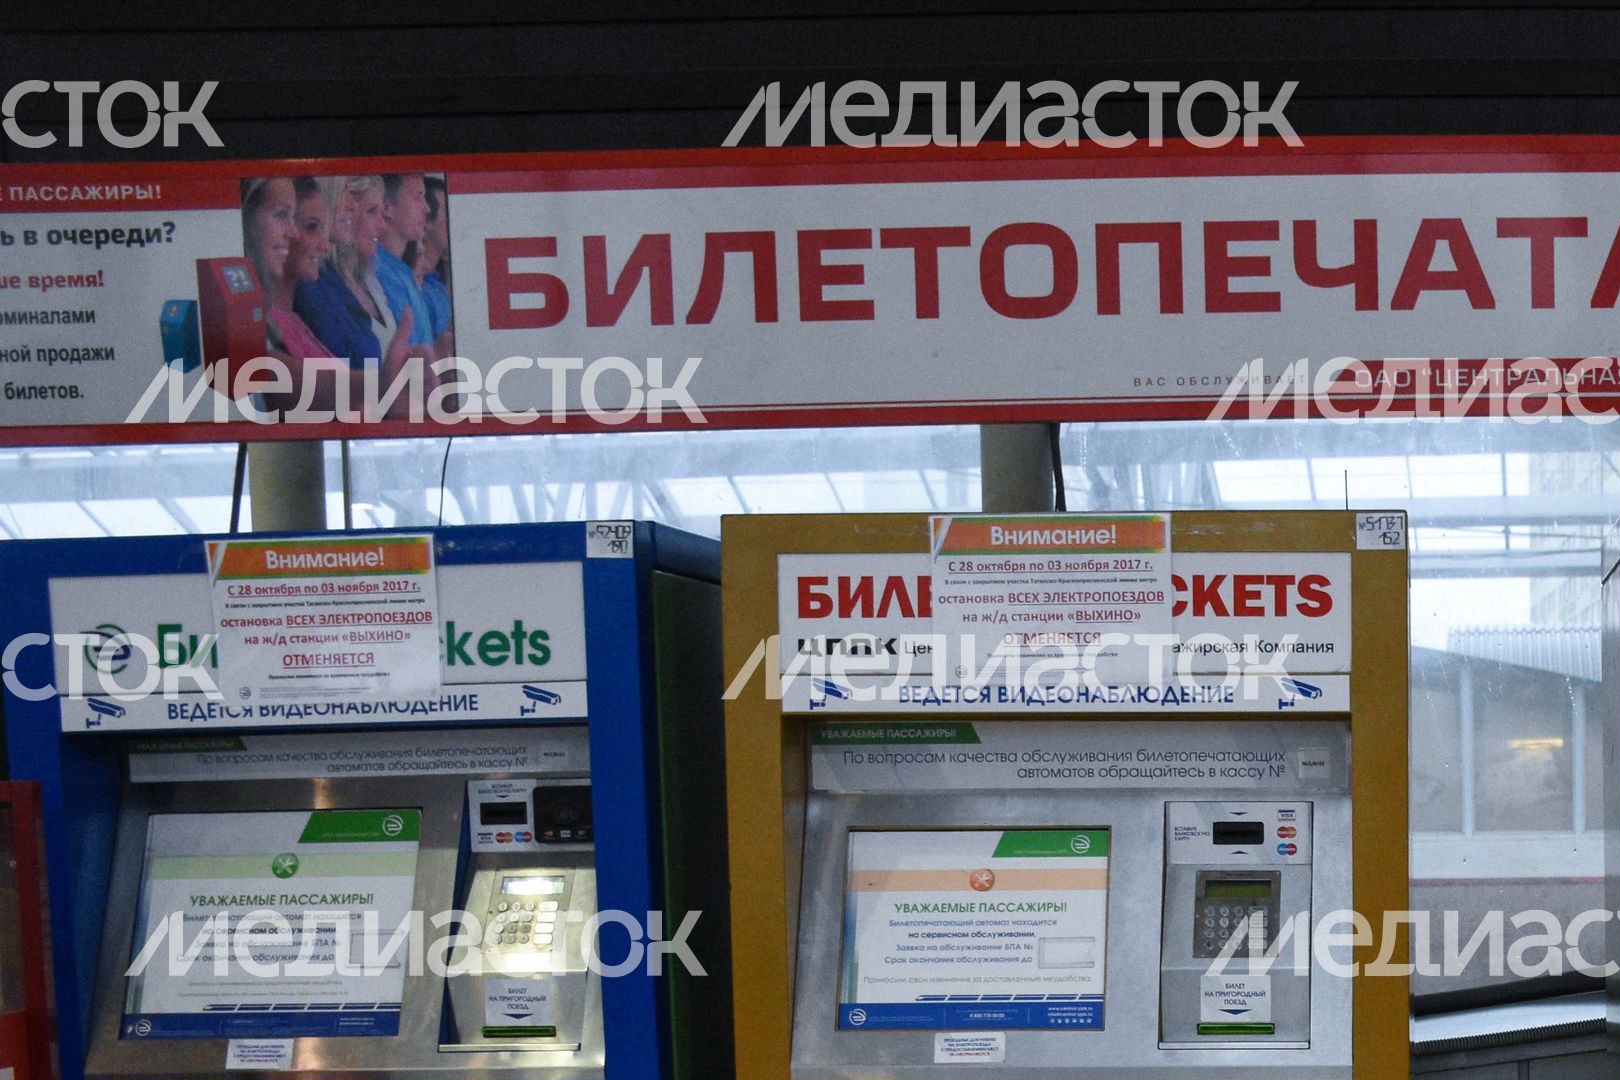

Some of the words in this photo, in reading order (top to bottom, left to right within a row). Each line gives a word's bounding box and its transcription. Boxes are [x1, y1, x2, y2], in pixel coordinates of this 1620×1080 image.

[9, 184, 162, 201] ПАССАЖИРЫ!
[23, 229, 38, 246] в
[46, 220, 176, 250] очереди?
[28, 269, 105, 293] время!
[36, 345, 115, 366] продажи
[1132, 375, 1168, 389] ВАС
[1353, 367, 1413, 389] ОАО
[4, 381, 85, 400] билетов.
[990, 525, 1116, 546] Внимание!
[265, 547, 385, 570] Внимание!
[255, 583, 301, 597] октября
[337, 582, 380, 596] ноября
[382, 580, 409, 592] 2017
[938, 593, 1004, 604] остановка
[1007, 592, 1041, 604] ВСЕХ
[1042, 590, 1164, 604] ЭЛЕКТРОПОЕЗДОВ
[220, 617, 283, 627] остановка
[285, 615, 316, 626] ВСЕХ
[319, 611, 433, 626] ЭЛЕКТРОПОЕЗДОВ
[1011, 611, 1064, 623] станции
[1067, 609, 1141, 622] «ВЫХИНО»
[289, 633, 338, 645] станции
[342, 630, 411, 643] «ВЫХИНО»
[1003, 633, 1101, 645] ОТМЕНЯЕТСЯ
[1253, 639, 1334, 657] Компания
[282, 652, 374, 667] ОТМЕНЯЕТСЯ
[899, 684, 995, 707] ВЕДЕТСЯ
[999, 684, 1235, 706] ВИДЕОНАБЛЮДЕНИЕ
[866, 751, 945, 769] вопросам
[949, 752, 1018, 766] качества
[1021, 748, 1133, 768] обслуживания
[1138, 748, 1285, 768] билетопечатающих
[1016, 766, 1095, 781] автоматов
[1098, 763, 1202, 783] обращайтесь
[1220, 767, 1267, 782] кассу
[189, 893, 277, 908] УВАЖАЕМЫЕ
[280, 892, 374, 906] ПАССАЖИРЫ!
[894, 903, 976, 914] УВАЖАЕМЫЕ
[978, 901, 1067, 913] ПАССАЖИРЫ!
